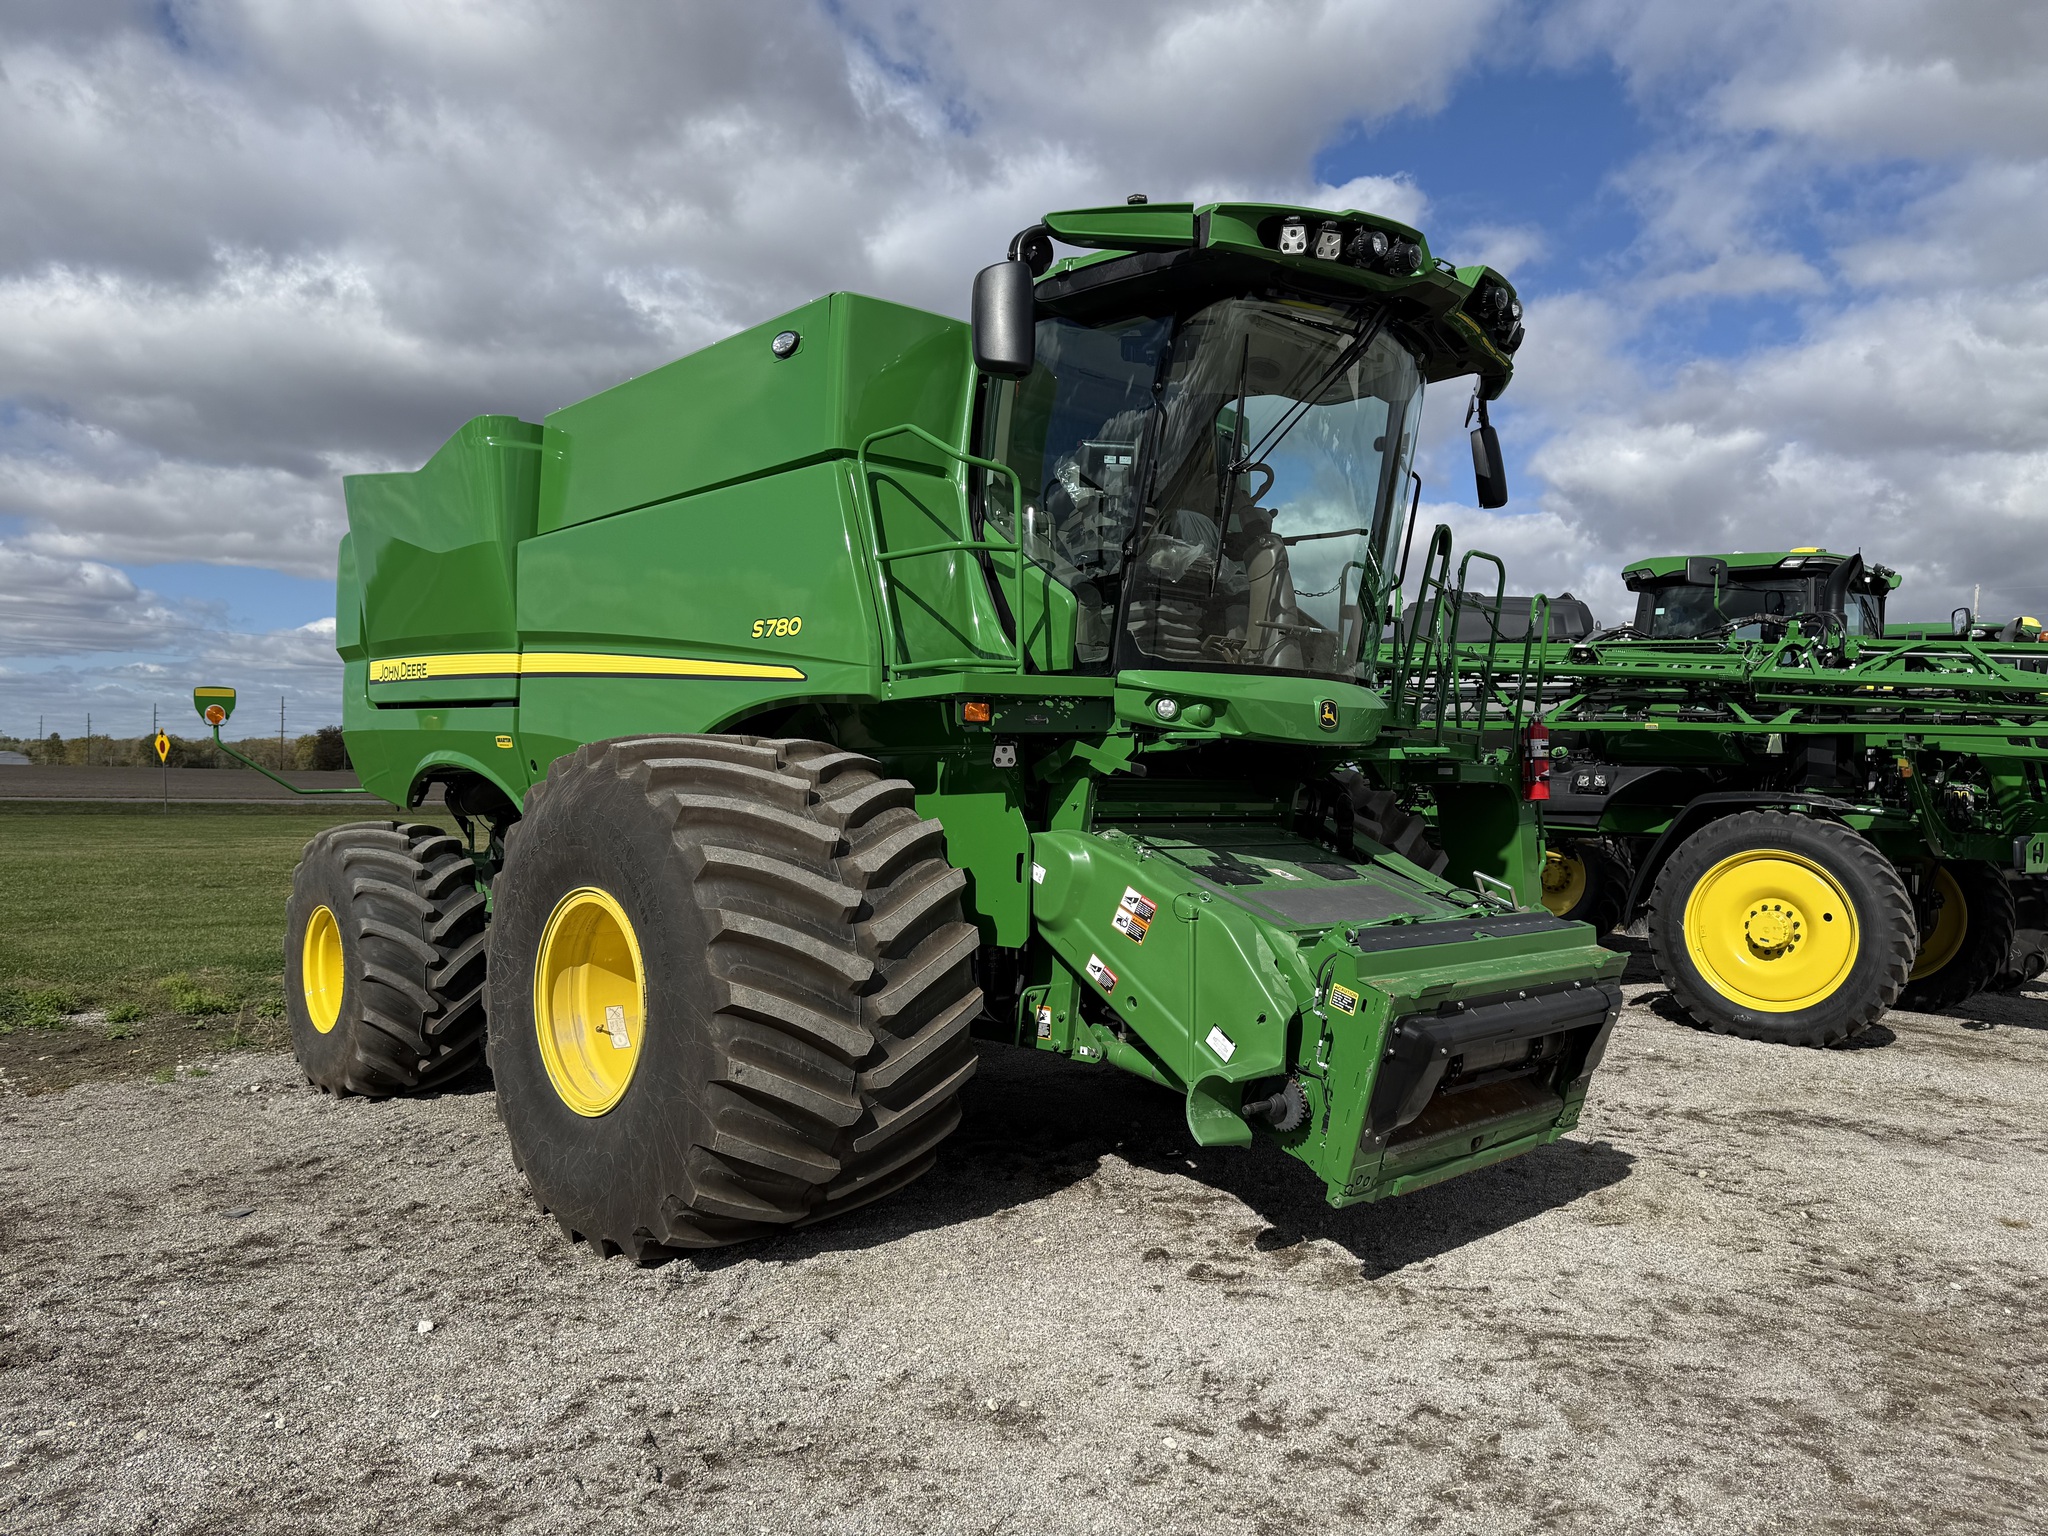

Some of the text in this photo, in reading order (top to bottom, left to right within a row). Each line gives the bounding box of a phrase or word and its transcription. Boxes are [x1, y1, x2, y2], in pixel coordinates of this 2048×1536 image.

[751, 615, 803, 639] S780
[379, 661, 428, 680] JOHN DEERE
